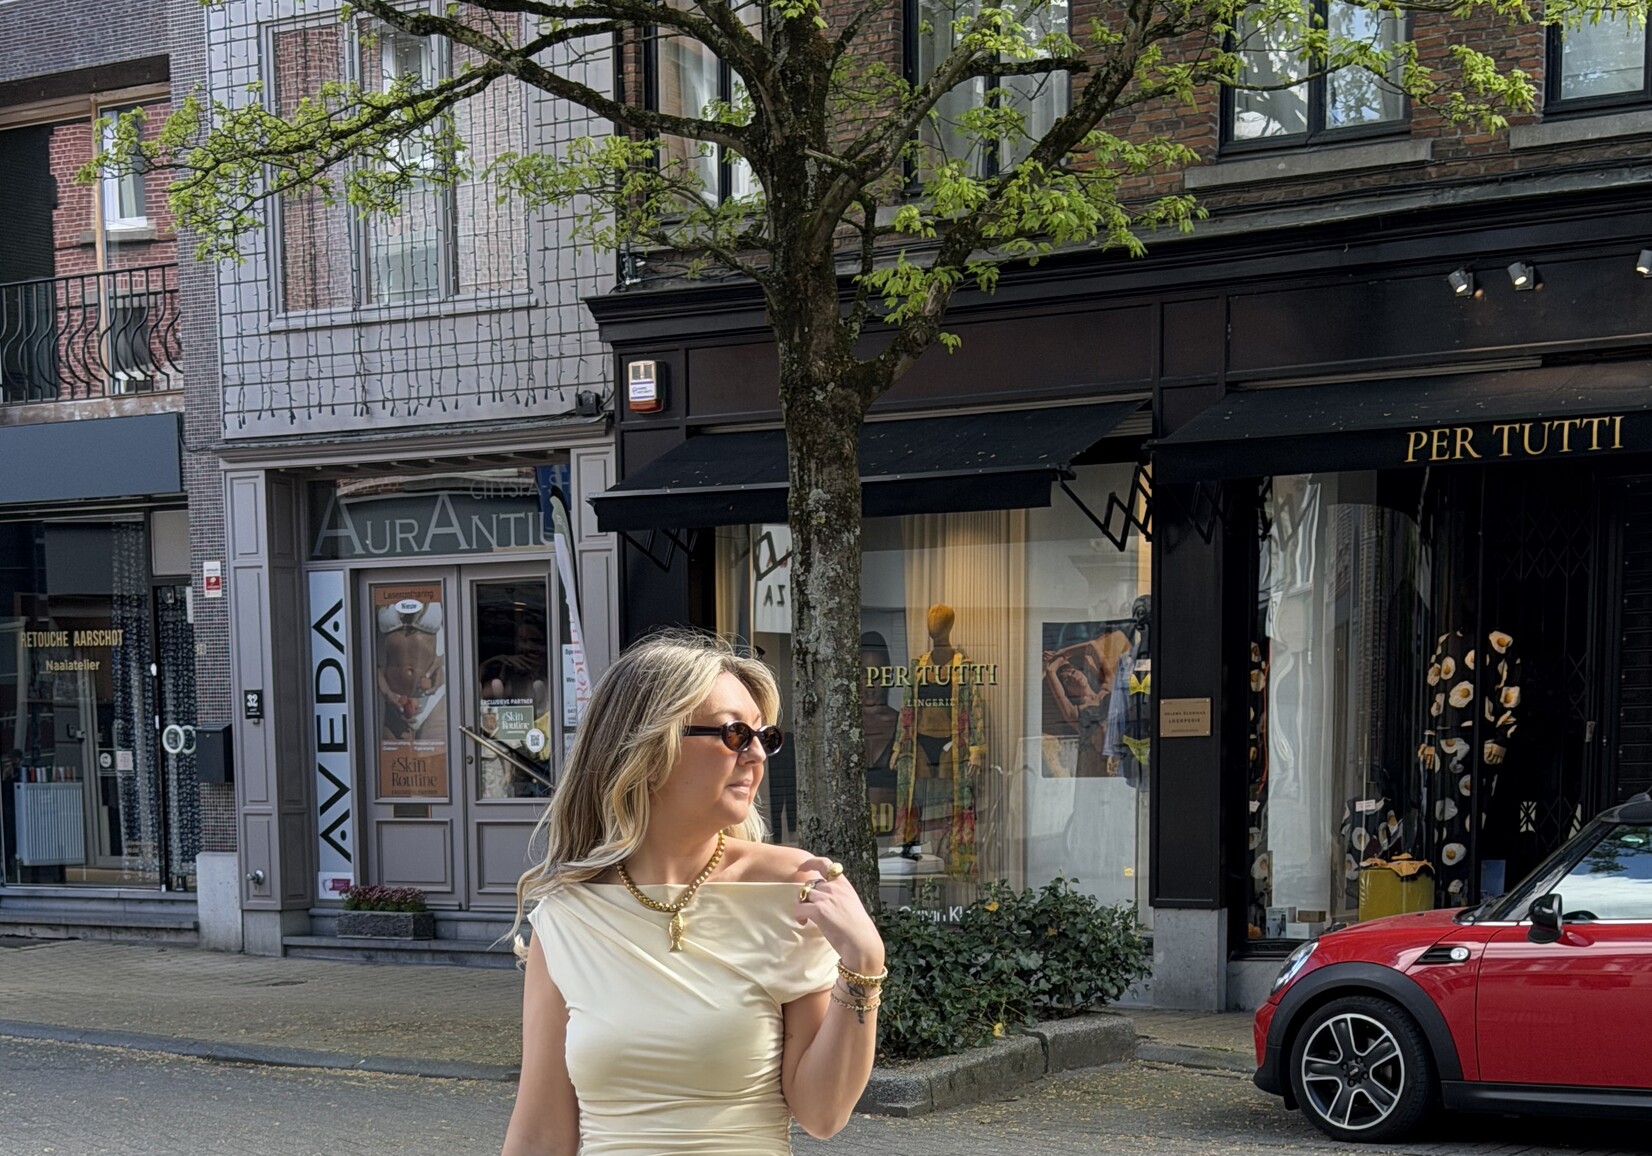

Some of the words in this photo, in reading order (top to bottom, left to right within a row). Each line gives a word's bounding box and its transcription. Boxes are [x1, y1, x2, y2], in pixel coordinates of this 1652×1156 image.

[1404, 427, 1482, 463] PER
[1493, 416, 1624, 457] TUTTI
[312, 488, 556, 556] AURANTIU
[21, 631, 69, 647] RETOUCHE
[73, 629, 123, 647] AARSCHOT
[46, 659, 100, 671] Naaiatelier
[866, 666, 911, 687] PER
[916, 664, 997, 686] TUTTI
[312, 598, 352, 863] AVEDA
[396, 756, 427, 772] Skin
[391, 772, 437, 787] Routine
